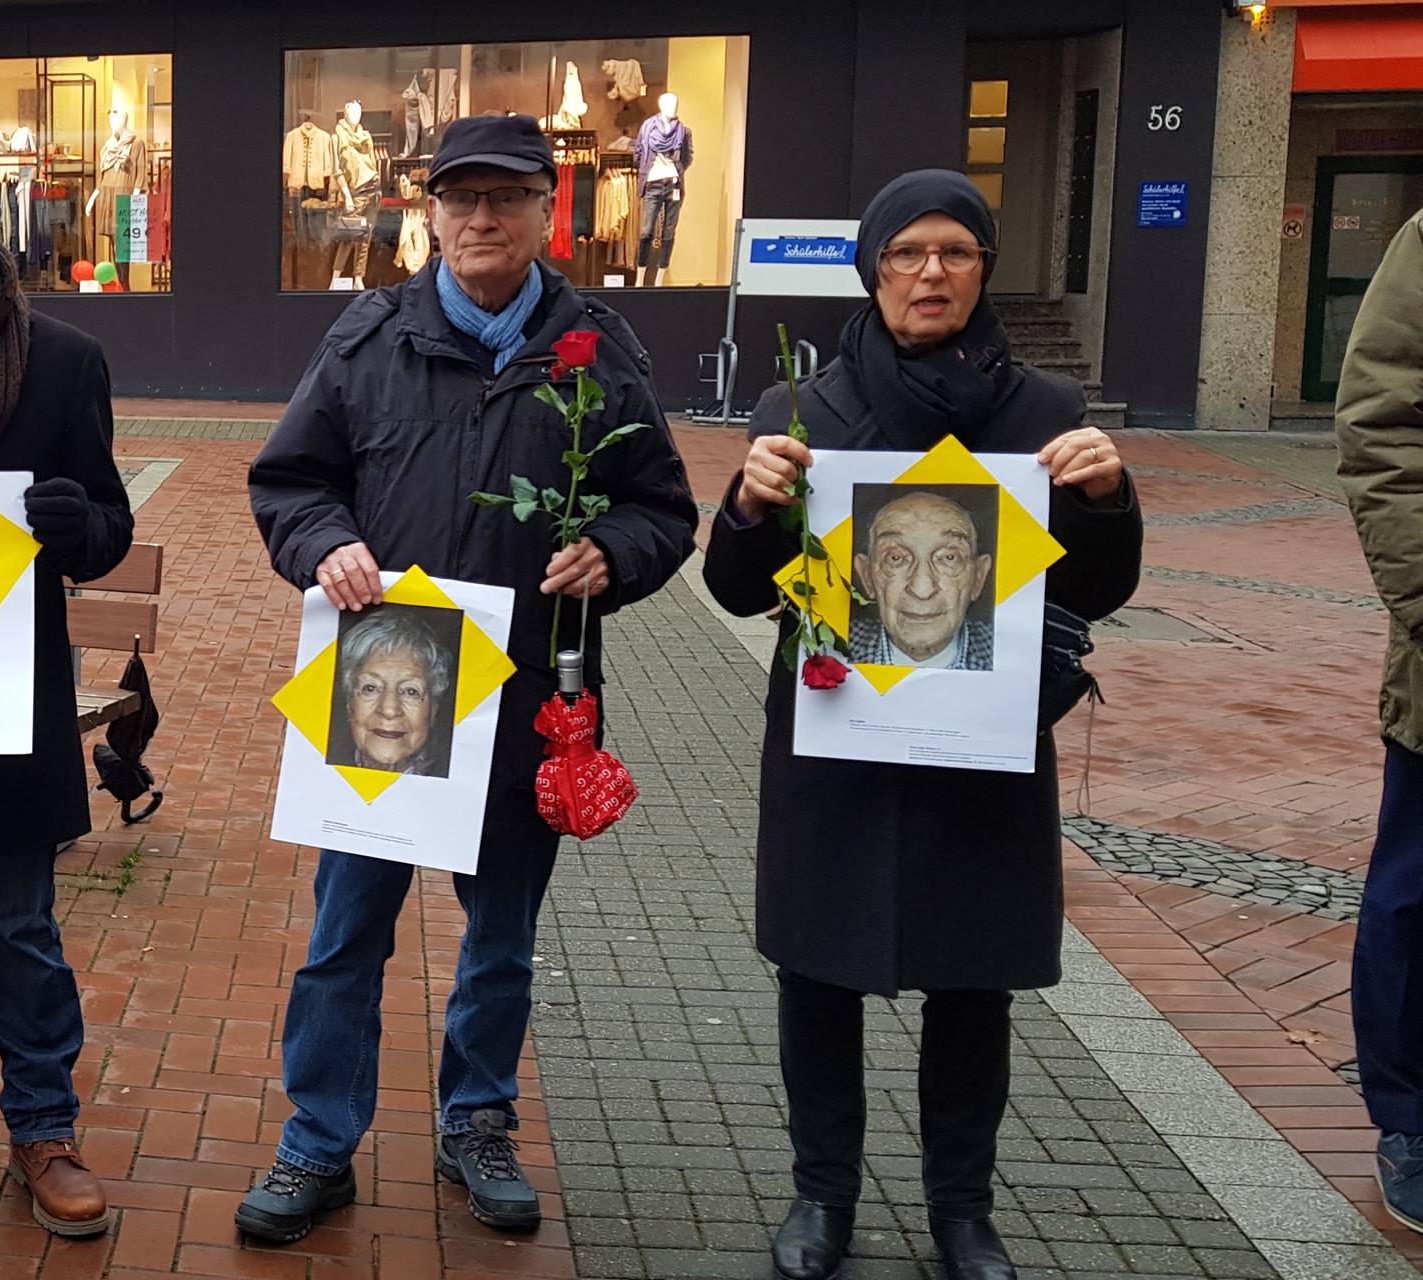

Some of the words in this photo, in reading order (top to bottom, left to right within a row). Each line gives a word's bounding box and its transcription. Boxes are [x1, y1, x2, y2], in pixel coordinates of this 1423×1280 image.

[1148, 104, 1183, 130] 56
[123, 227, 141, 239] 49
[535, 777, 550, 788] Gu
[539, 791, 556, 803] Gu
[579, 784, 597, 800] Gut
[600, 797, 619, 812] Gut
[581, 805, 594, 818] Gu
